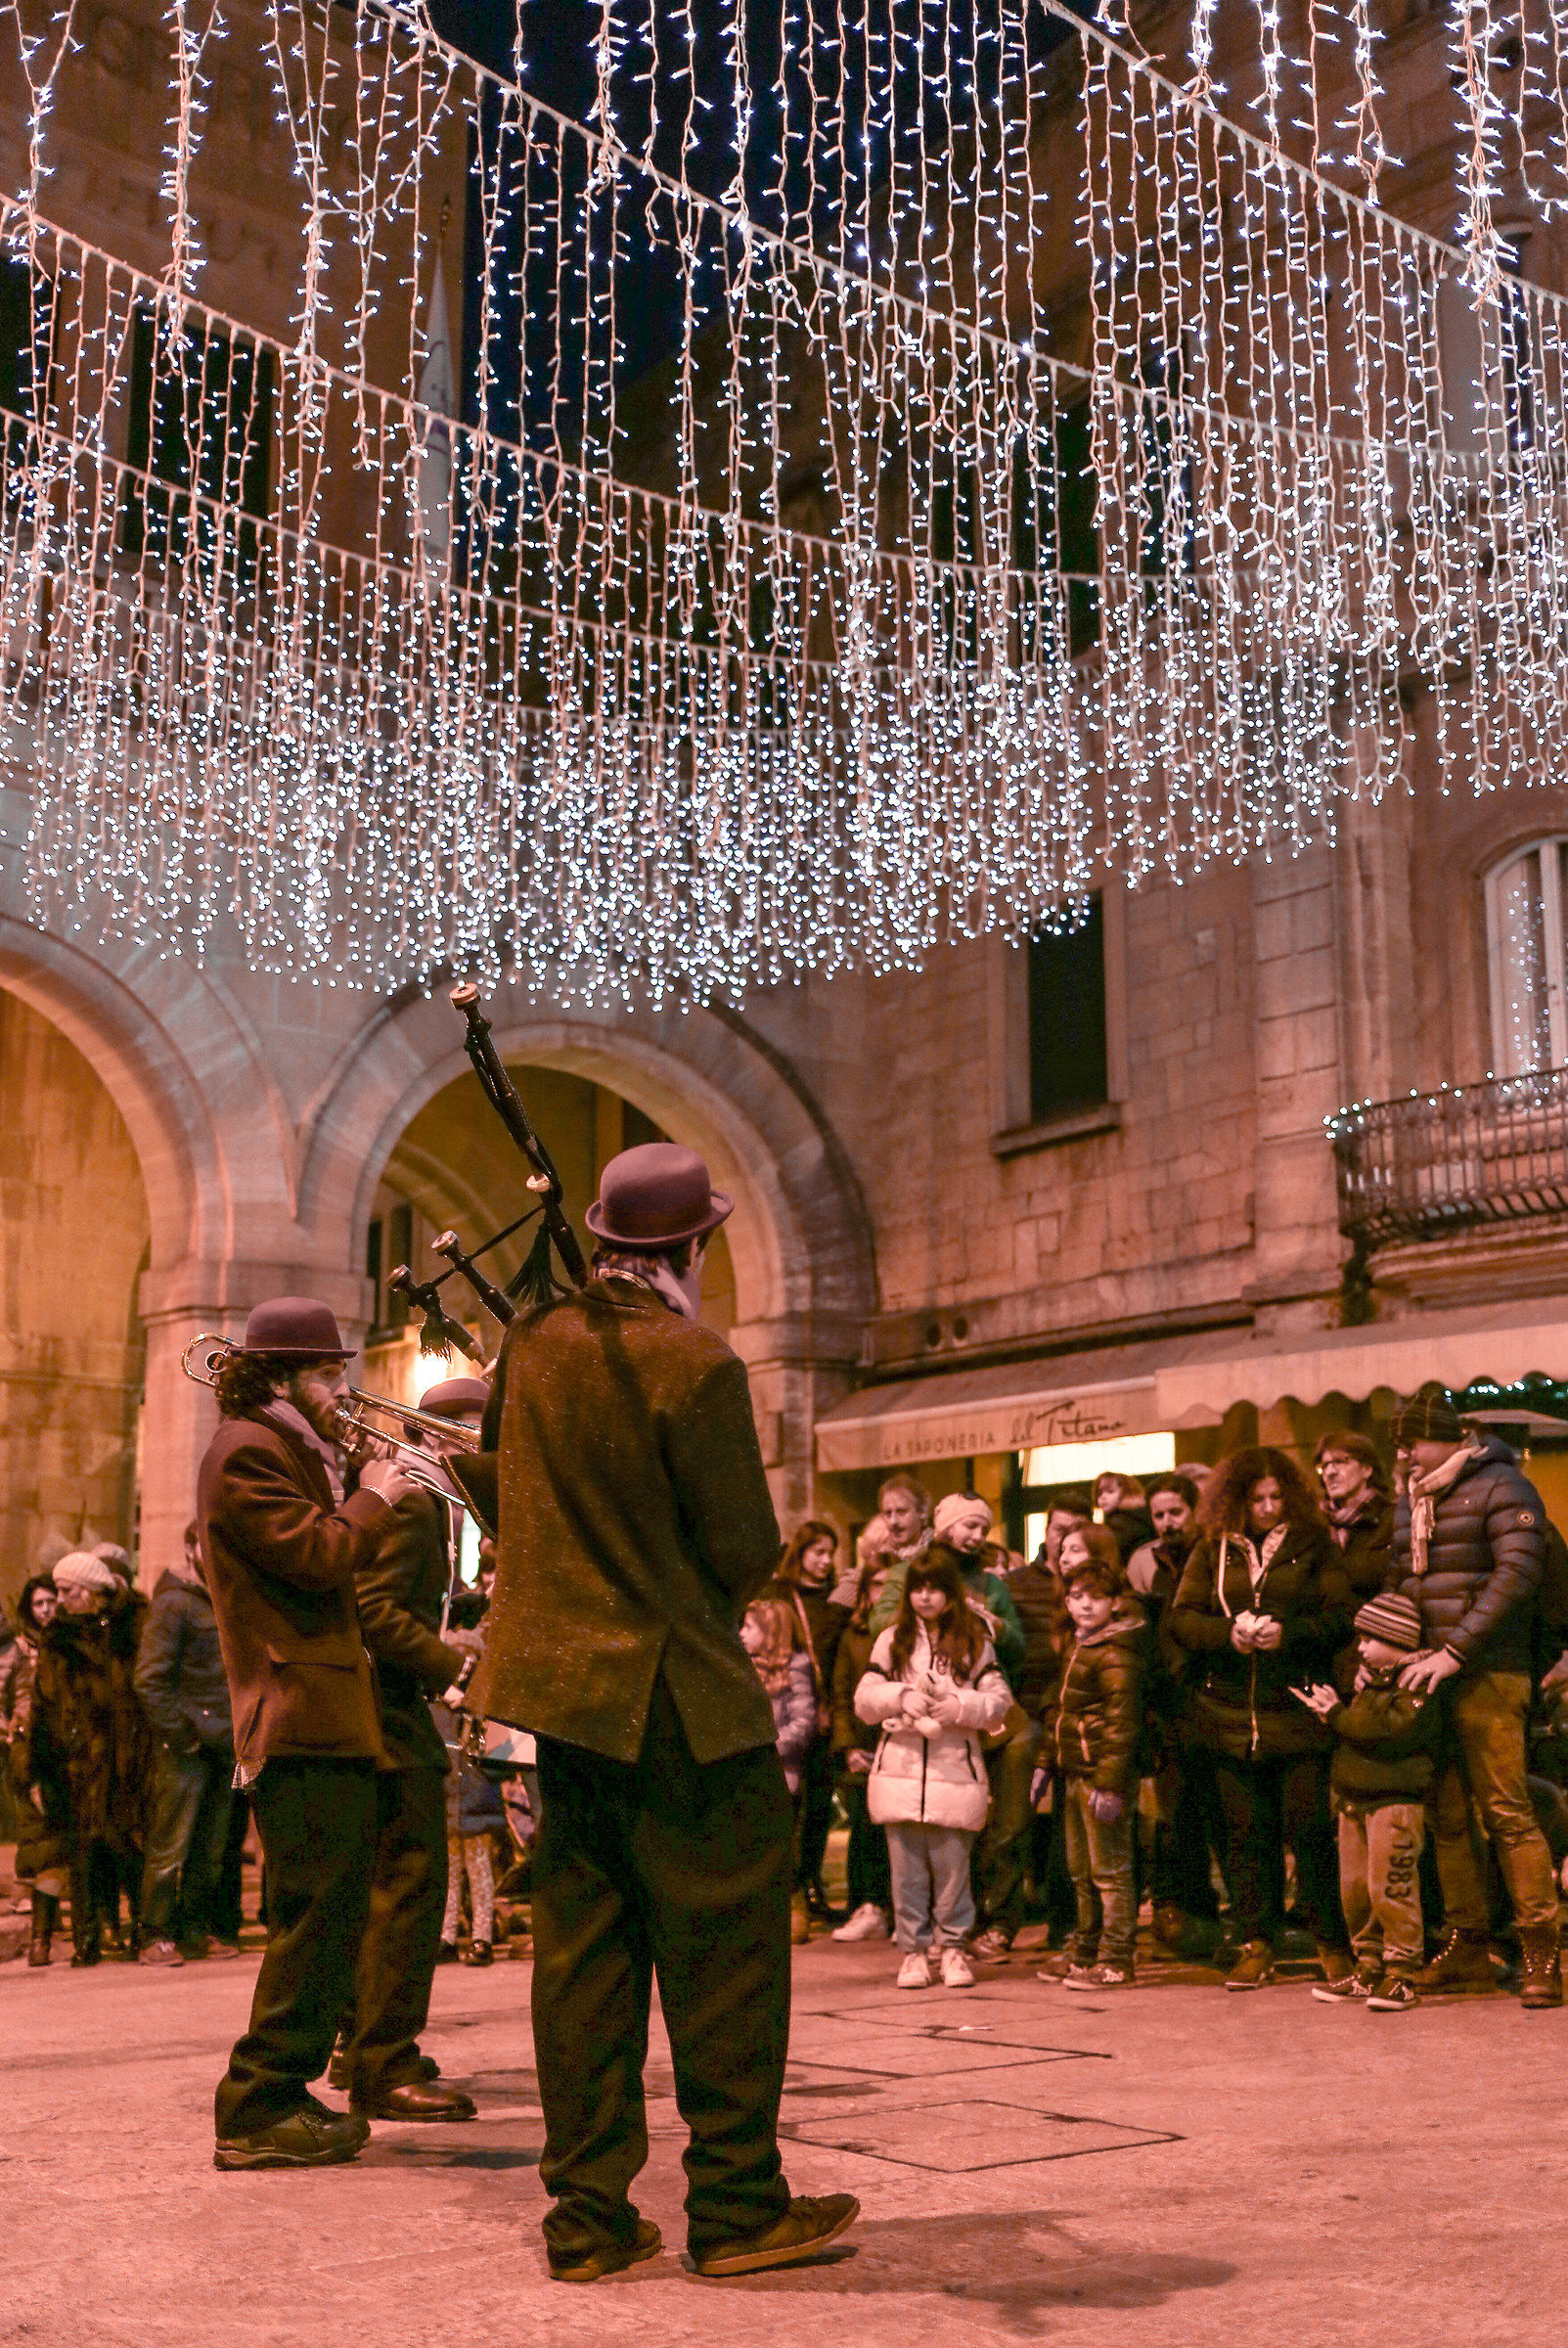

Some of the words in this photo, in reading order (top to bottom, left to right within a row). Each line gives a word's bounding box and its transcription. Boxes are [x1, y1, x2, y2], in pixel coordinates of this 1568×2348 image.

[883, 1443, 900, 1460] LA
[906, 1431, 996, 1457] SAPONERIA
[1035, 1399, 1125, 1446] Titano
